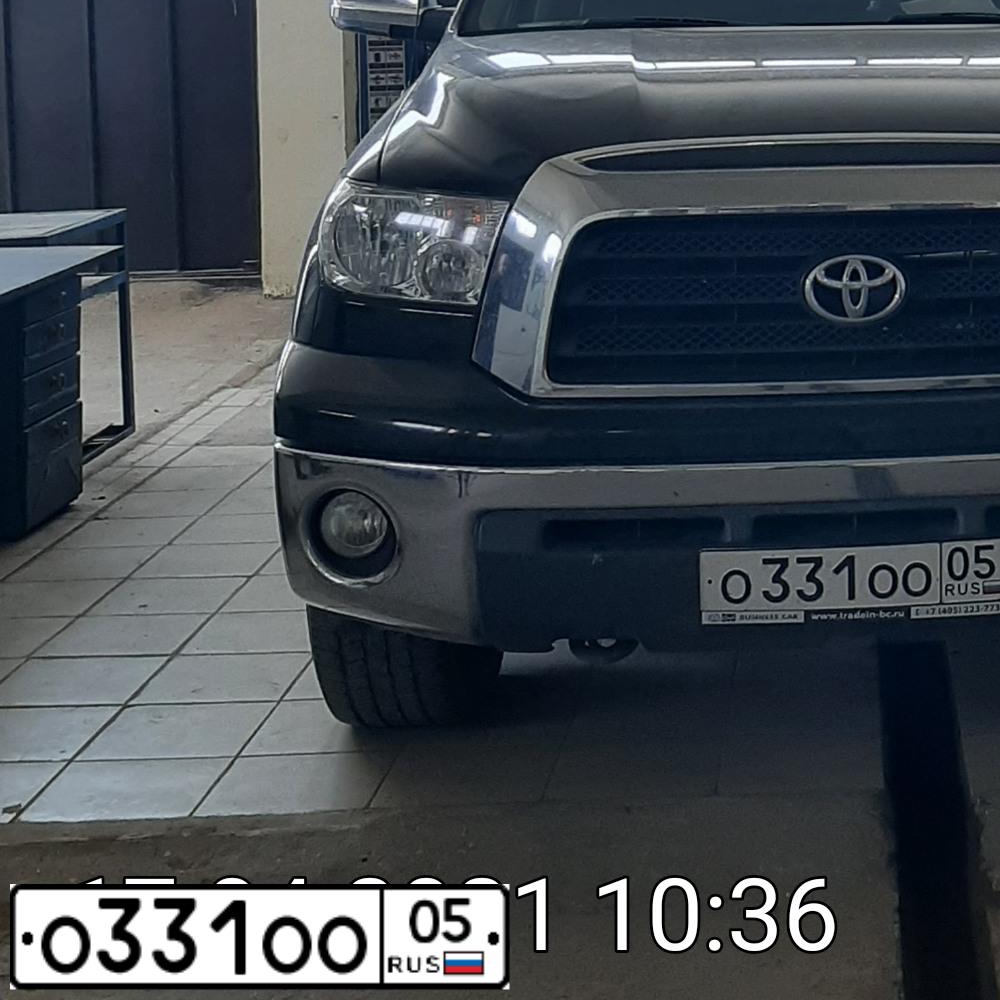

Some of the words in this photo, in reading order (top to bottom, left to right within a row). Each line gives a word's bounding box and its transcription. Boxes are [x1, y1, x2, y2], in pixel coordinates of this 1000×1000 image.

[947, 545, 995, 581] 05
[945, 582, 981, 597] RUS
[811, 610, 905, 621] www.tradein-bc.ru
